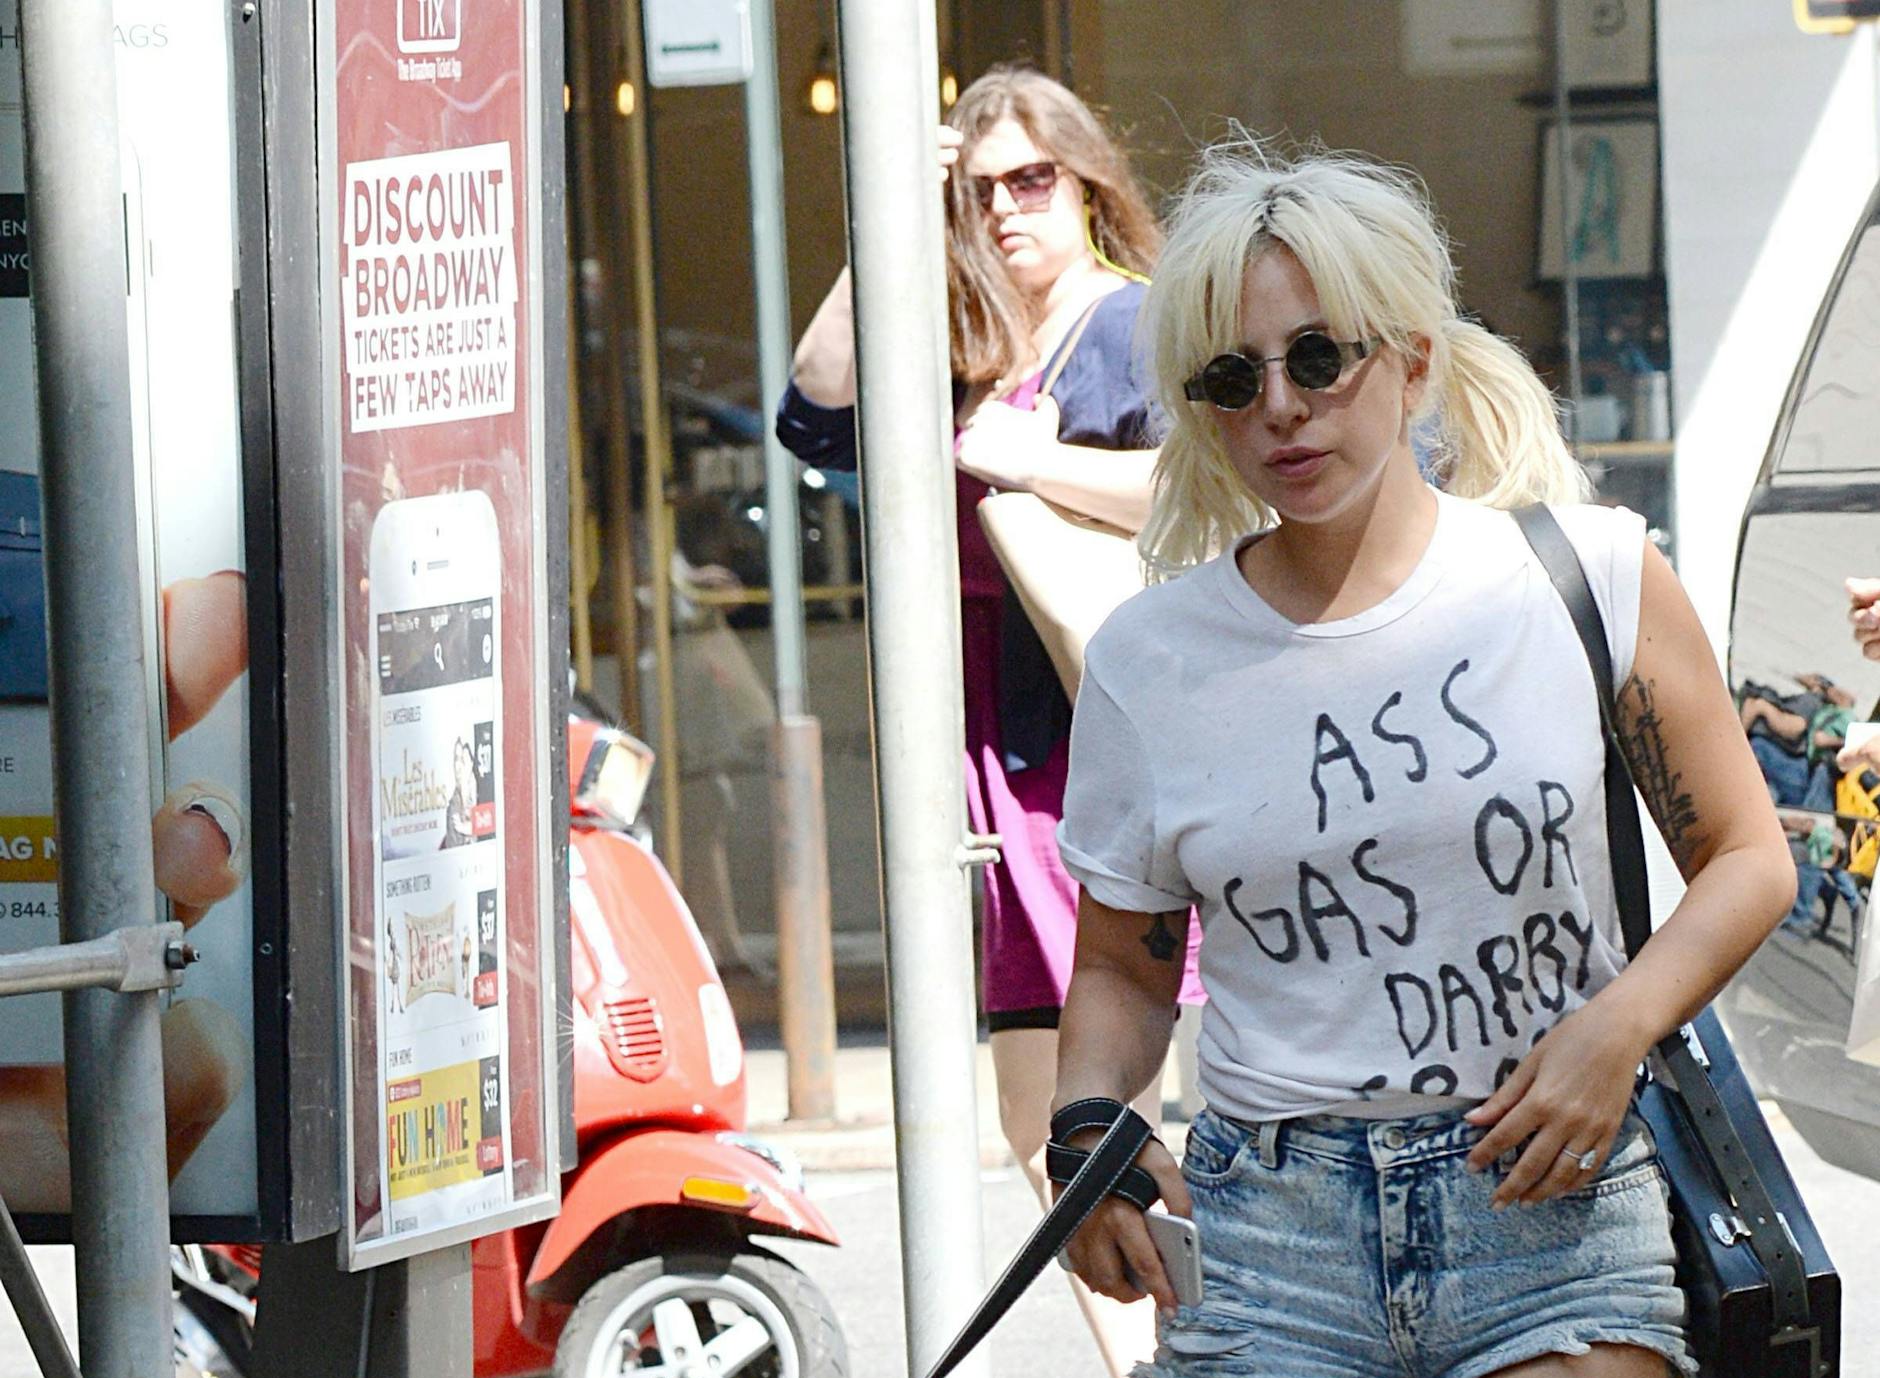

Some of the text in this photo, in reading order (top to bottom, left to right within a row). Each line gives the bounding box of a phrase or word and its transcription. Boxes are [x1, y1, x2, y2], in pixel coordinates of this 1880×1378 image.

[354, 169, 503, 247] DISCOUNT
[355, 246, 504, 317] BROADWAY
[355, 316, 507, 364] TICKETS ARE JUST A
[355, 361, 508, 420] FEW TAPS AWAY
[1311, 659, 1498, 833] ASS
[1224, 780, 1579, 964] GAS OR
[1385, 911, 1595, 1060] DARBY
[389, 1108, 419, 1169] FUN
[424, 1097, 469, 1160] HOME
